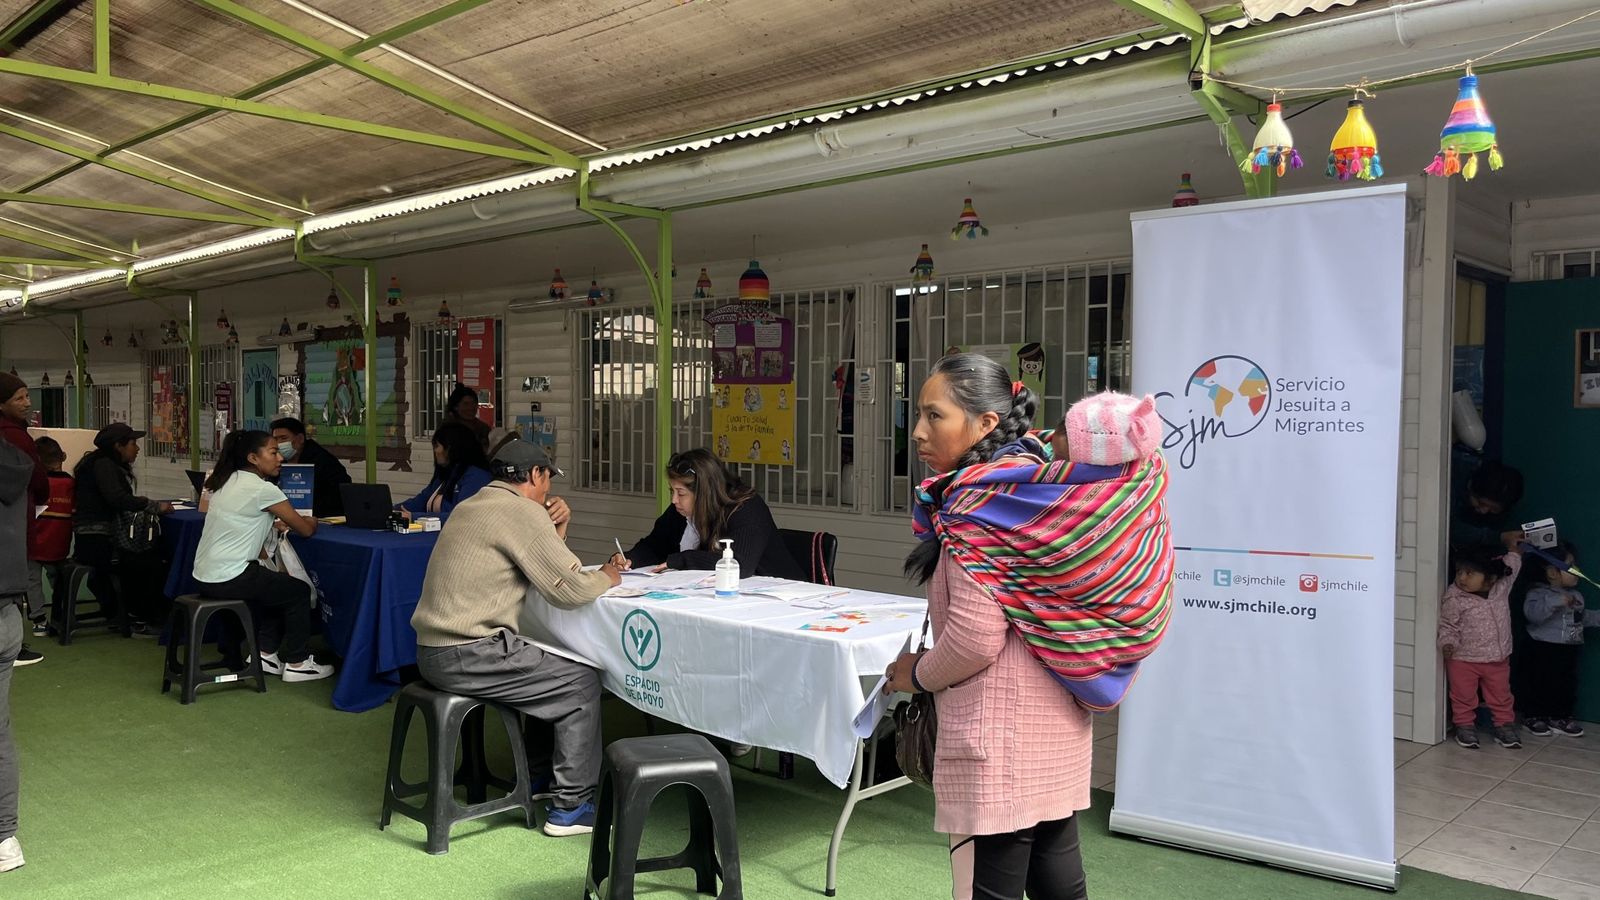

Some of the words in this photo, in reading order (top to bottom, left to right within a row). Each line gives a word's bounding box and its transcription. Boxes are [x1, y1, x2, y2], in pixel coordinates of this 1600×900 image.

[1275, 376, 1345, 392] Servicio
[1275, 398, 1336, 413] Jesuita
[1341, 401, 1351, 412] a
[1275, 417, 1365, 435] Migrantes
[1233, 574, 1286, 587] @sjmchile
[1321, 579, 1368, 592] sjmchile
[1183, 597, 1317, 620] www.sjmchile.org
[625, 675, 660, 693] ESPACIO
[636, 692, 663, 709] APOYO
